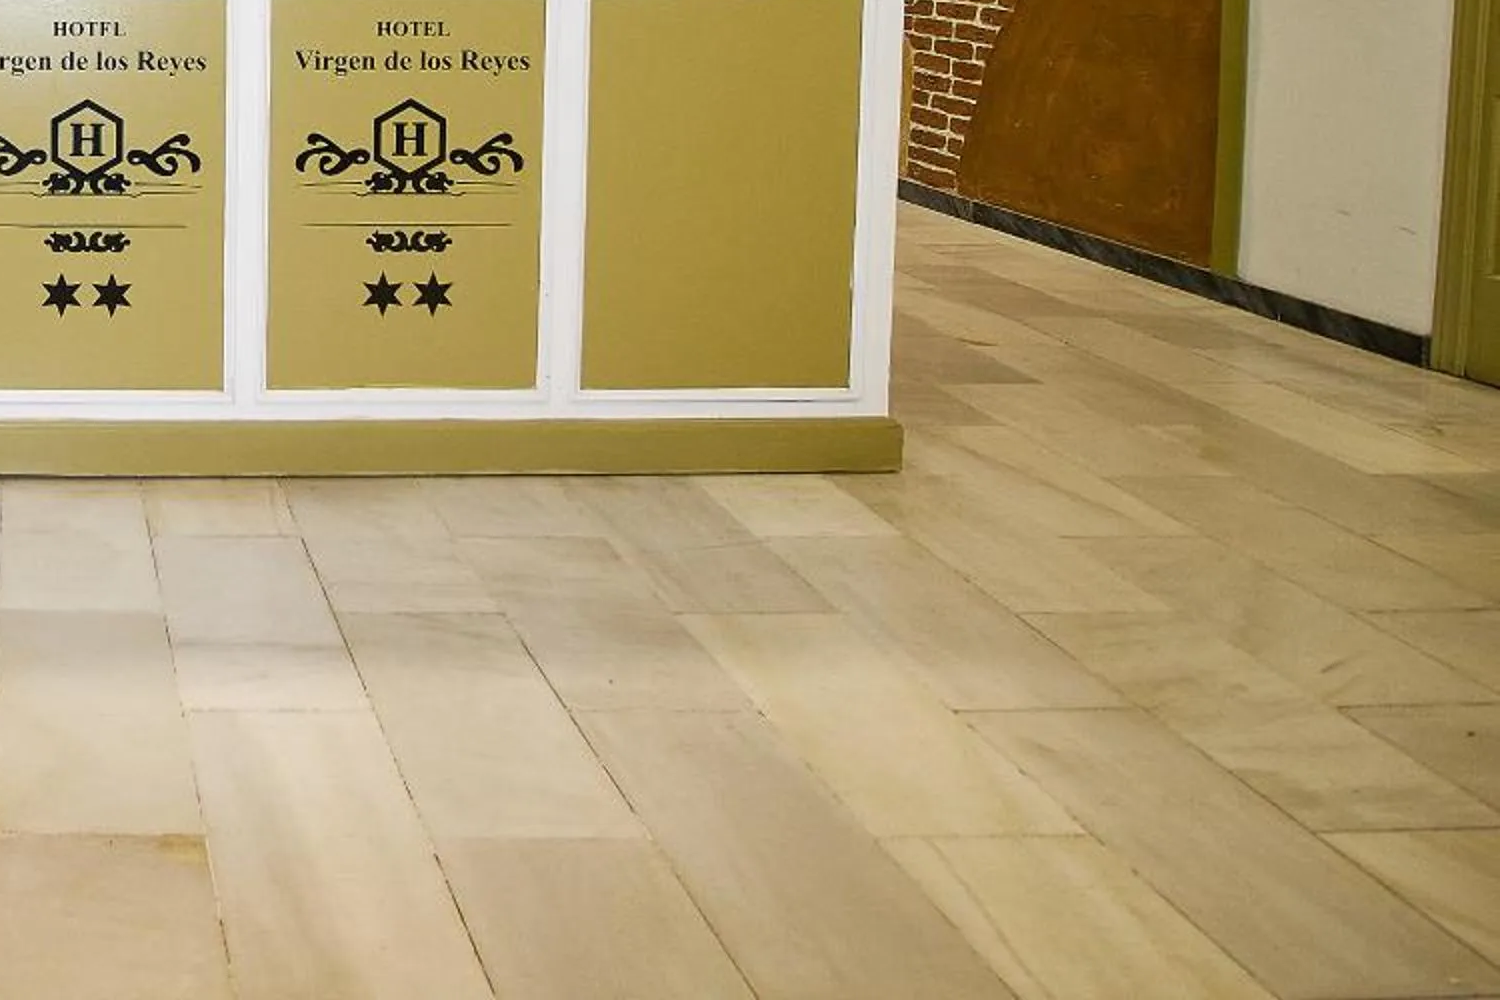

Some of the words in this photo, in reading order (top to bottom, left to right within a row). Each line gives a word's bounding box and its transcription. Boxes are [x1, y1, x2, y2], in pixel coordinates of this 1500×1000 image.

[53, 21, 127, 37] HOTEL
[376, 21, 450, 37] HOTEL
[60, 51, 89, 71] de
[96, 51, 129, 71] los
[137, 51, 207, 76] Reyes
[295, 50, 375, 76] Virgen
[384, 50, 413, 71] de
[420, 50, 453, 71] los
[460, 50, 531, 76] Reyes
[69, 122, 105, 157] H
[392, 122, 428, 157] H
